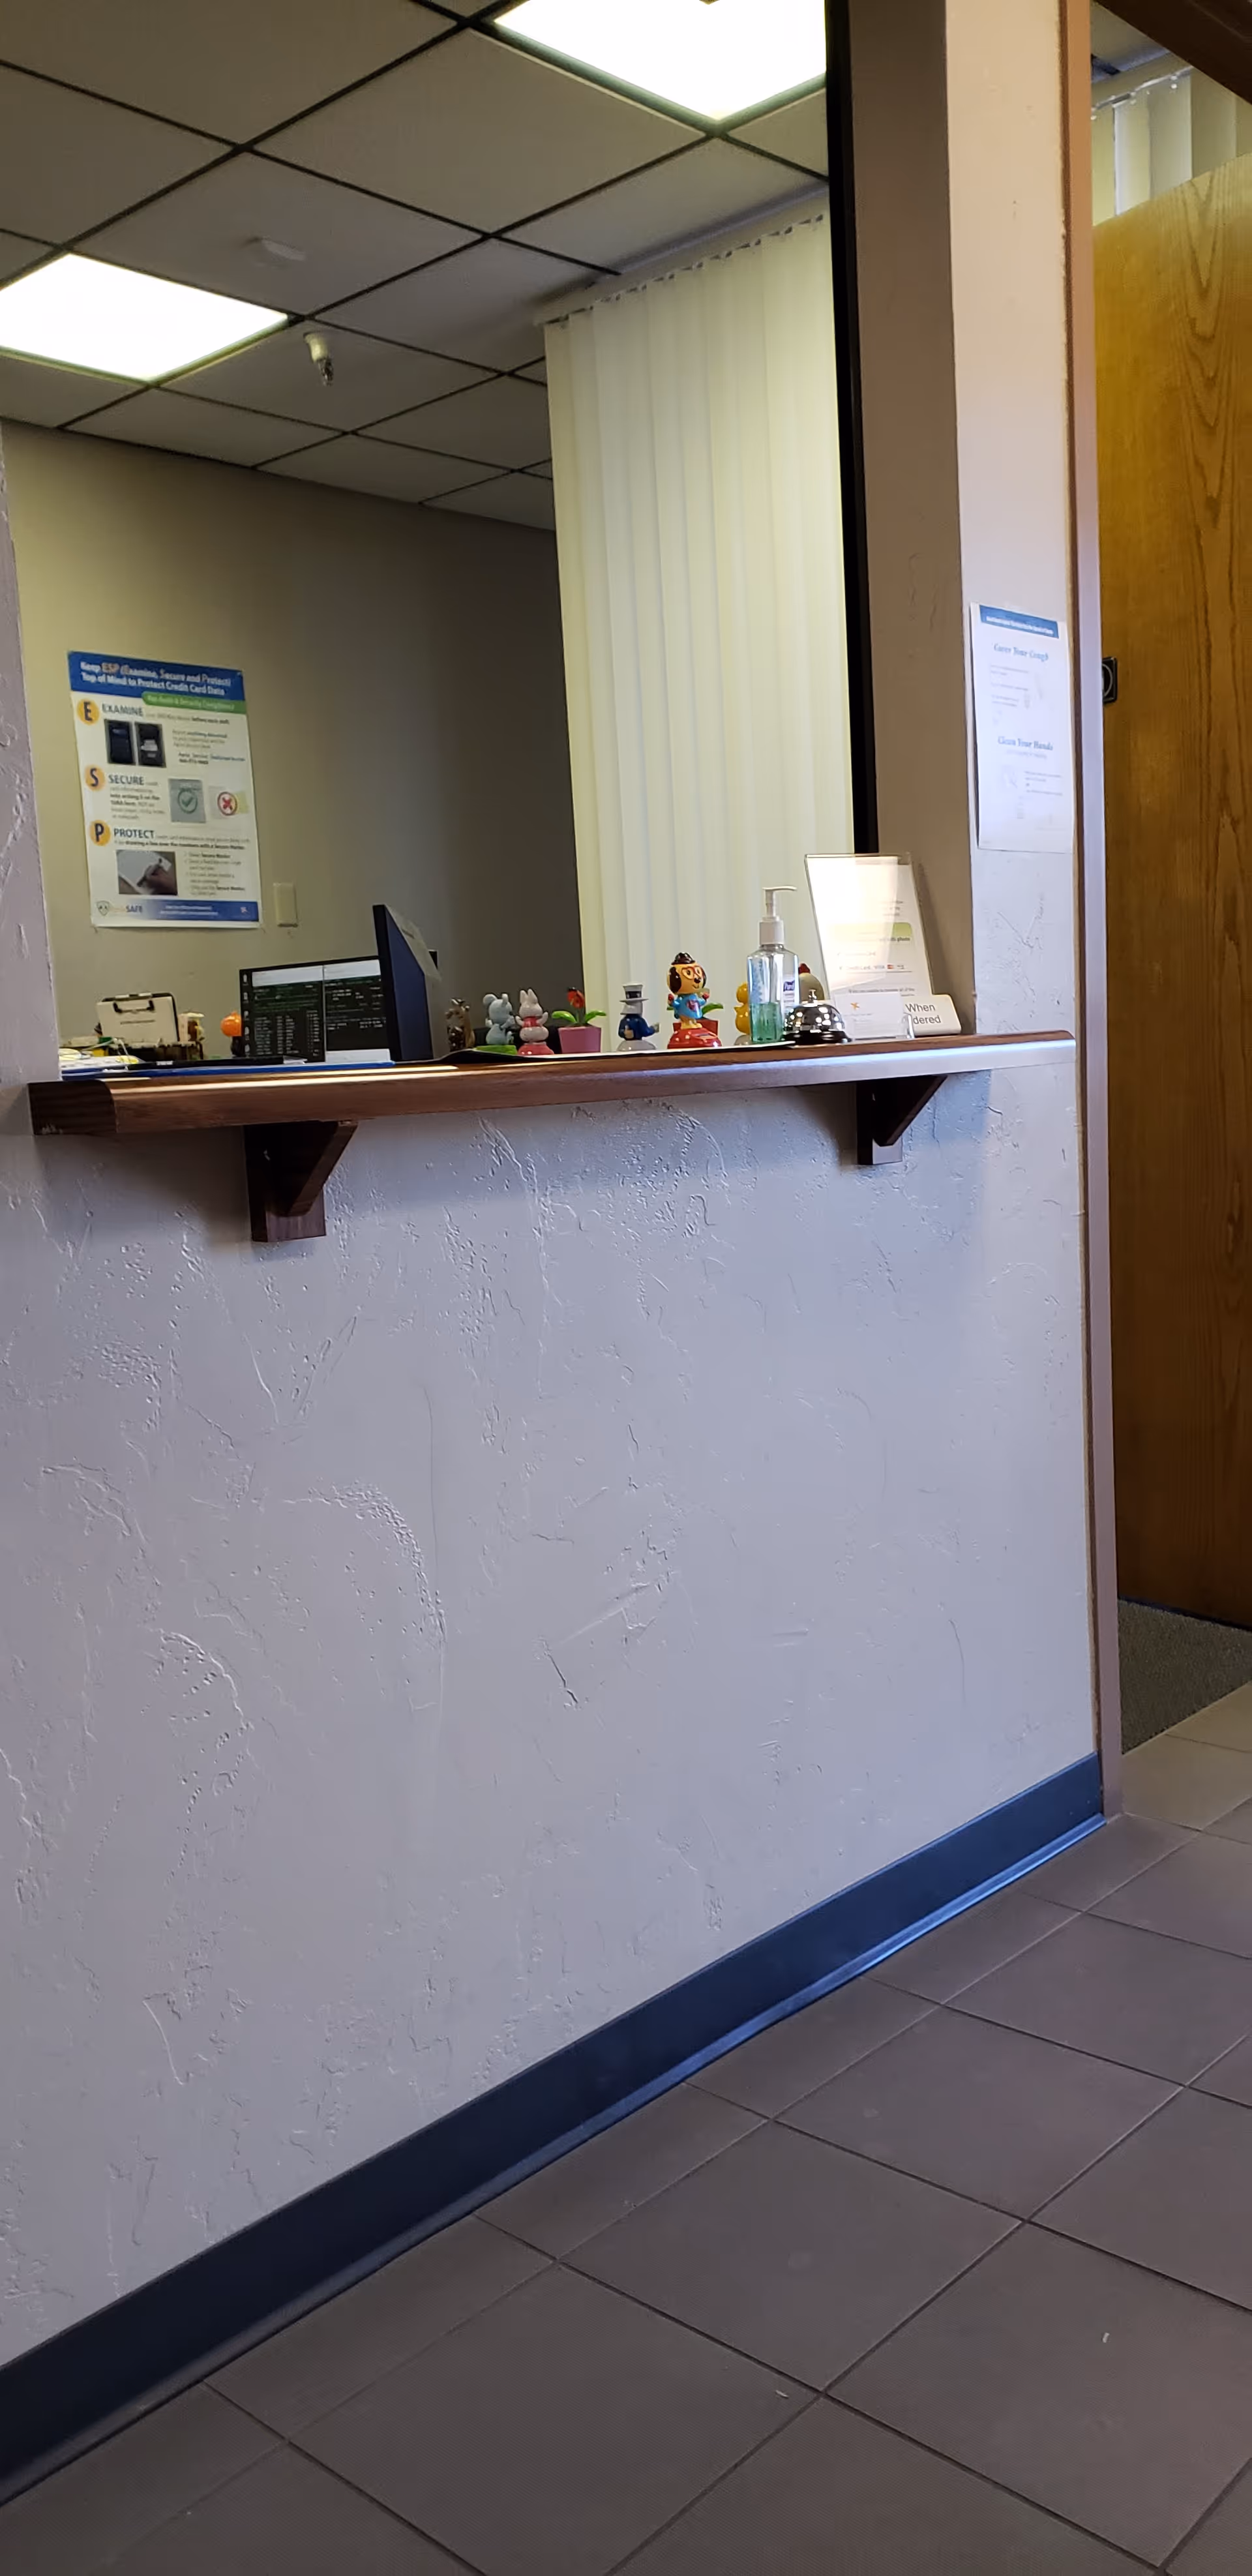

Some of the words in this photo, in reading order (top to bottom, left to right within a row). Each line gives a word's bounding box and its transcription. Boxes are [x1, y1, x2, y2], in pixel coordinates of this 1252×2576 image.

[80, 661, 102, 674] Keep
[102, 662, 119, 674] ESP
[159, 668, 186, 681] Secure
[186, 674, 201, 682] and
[81, 672, 97, 683] Top
[97, 674, 106, 683] of
[107, 675, 128, 685] Mind
[128, 678, 137, 686] to
[138, 678, 165, 690] Protect
[166, 681, 189, 692] Credit
[190, 683, 207, 693] Card
[207, 685, 226, 696] Data
[83, 701, 93, 721] E
[102, 704, 143, 717] EXAMINE
[997, 736, 1016, 746] Clean
[1017, 738, 1032, 747] Your
[1034, 740, 1054, 751] Hands
[90, 768, 99, 787] S
[108, 774, 145, 786] SECURE
[95, 823, 104, 843] P
[113, 828, 155, 839] PROTECT
[126, 905, 142, 913] SAFE
[904, 1003, 936, 1013] When
[912, 1015, 942, 1025] dered
